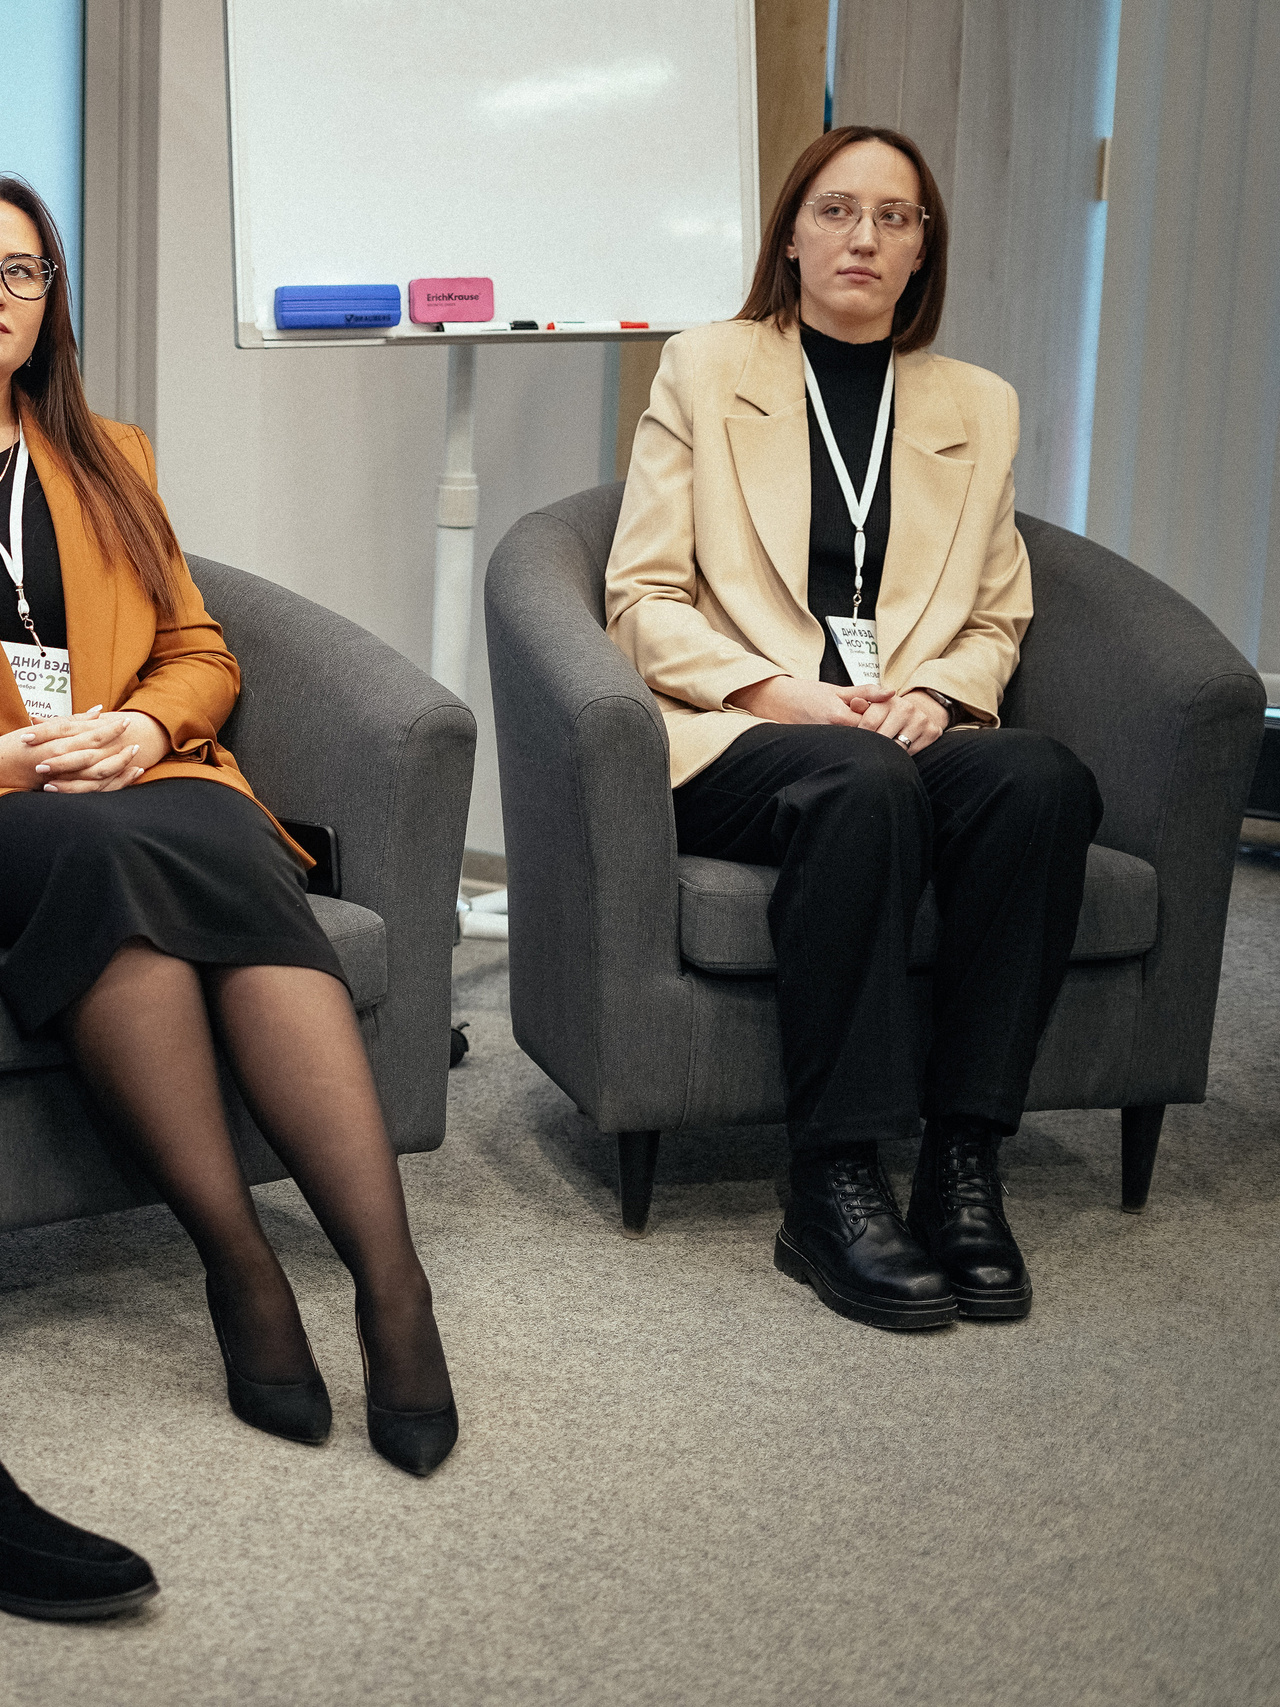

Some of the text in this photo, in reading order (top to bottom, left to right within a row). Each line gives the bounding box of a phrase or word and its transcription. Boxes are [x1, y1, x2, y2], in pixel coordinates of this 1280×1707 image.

[426, 292, 479, 302] ErichKrause
[841, 627, 875, 639] ДНИ ВЭД
[845, 638, 862, 648] НСО
[10, 655, 70, 675] ДНИ ВЭД
[24, 699, 52, 710] ЛИНА
